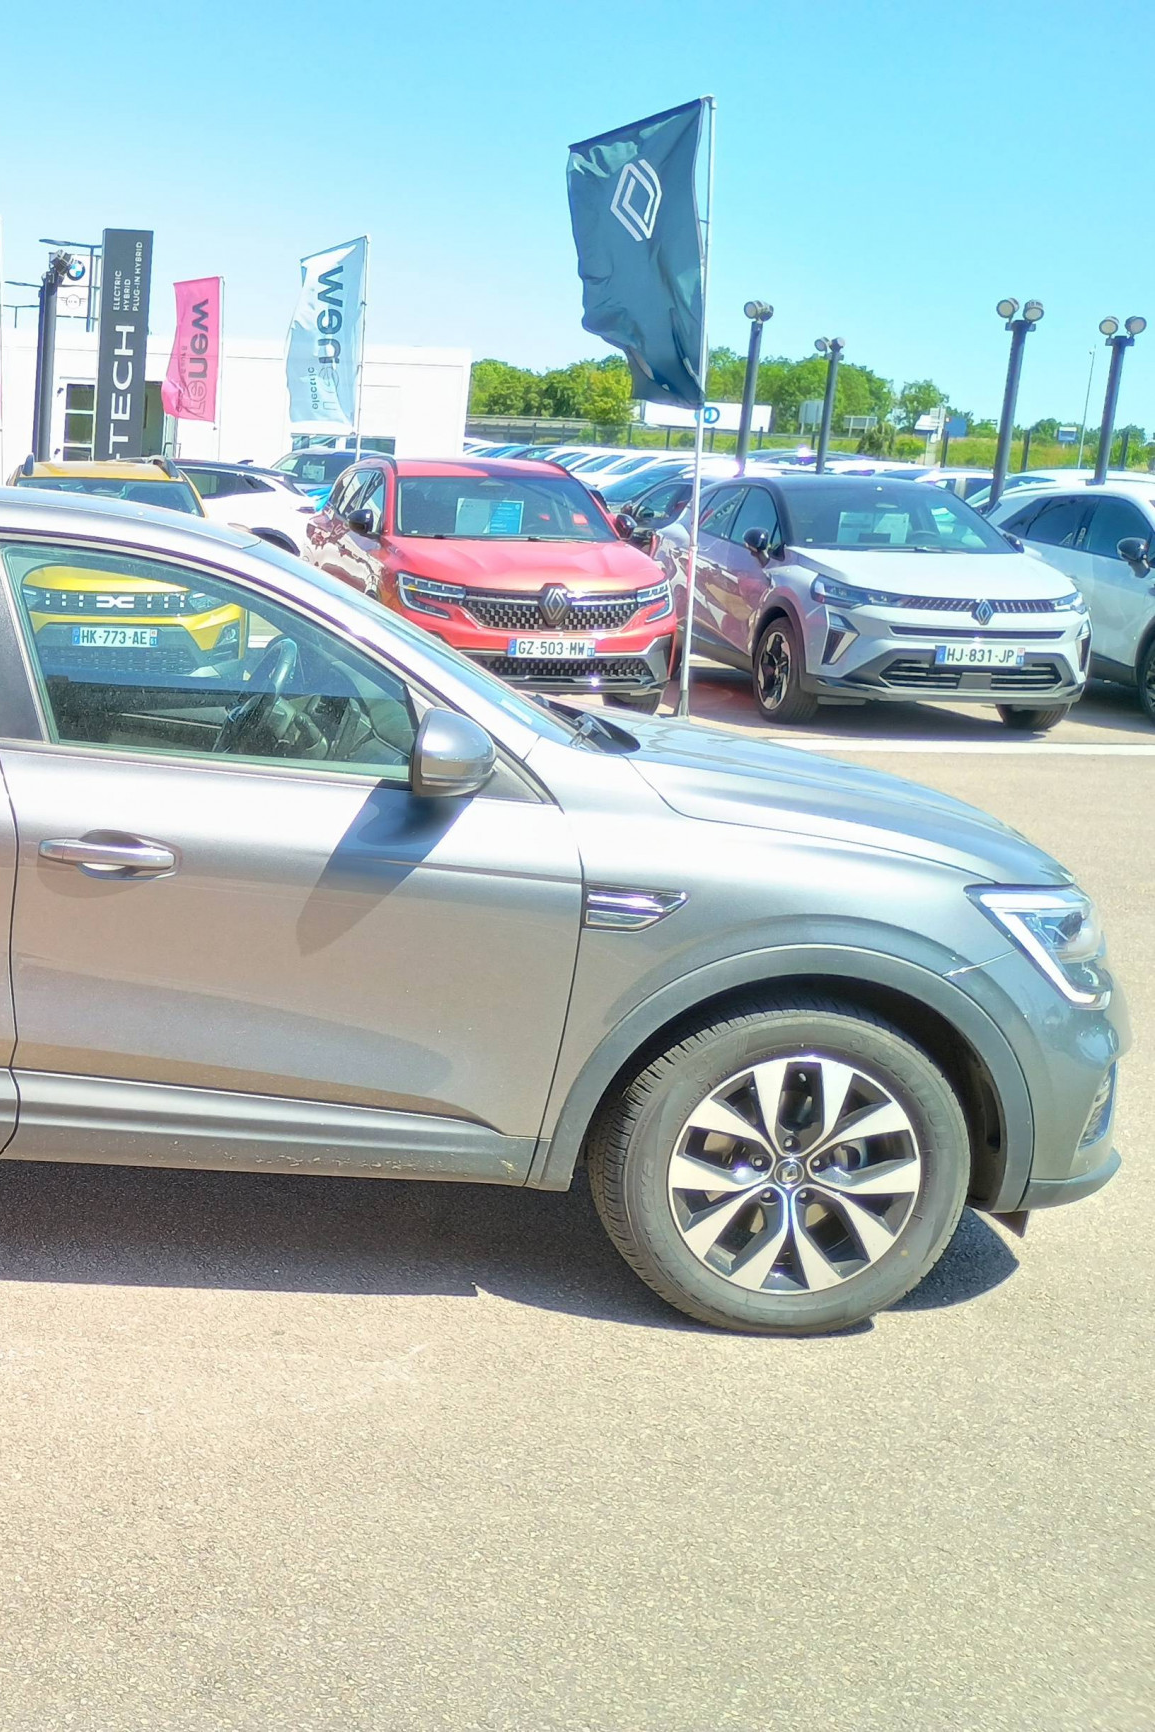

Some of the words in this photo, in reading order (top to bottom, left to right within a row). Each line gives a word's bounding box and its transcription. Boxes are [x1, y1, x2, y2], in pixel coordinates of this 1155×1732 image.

[134, 241, 143, 275] HYBRID
[113, 270, 122, 311] ELECTRIC
[123, 279, 131, 311] HYBRID
[132, 276, 141, 312] PLUG-IN
[81, 629, 147, 645] HK-773-AE
[947, 647, 1015, 663] HJ-831-JP
